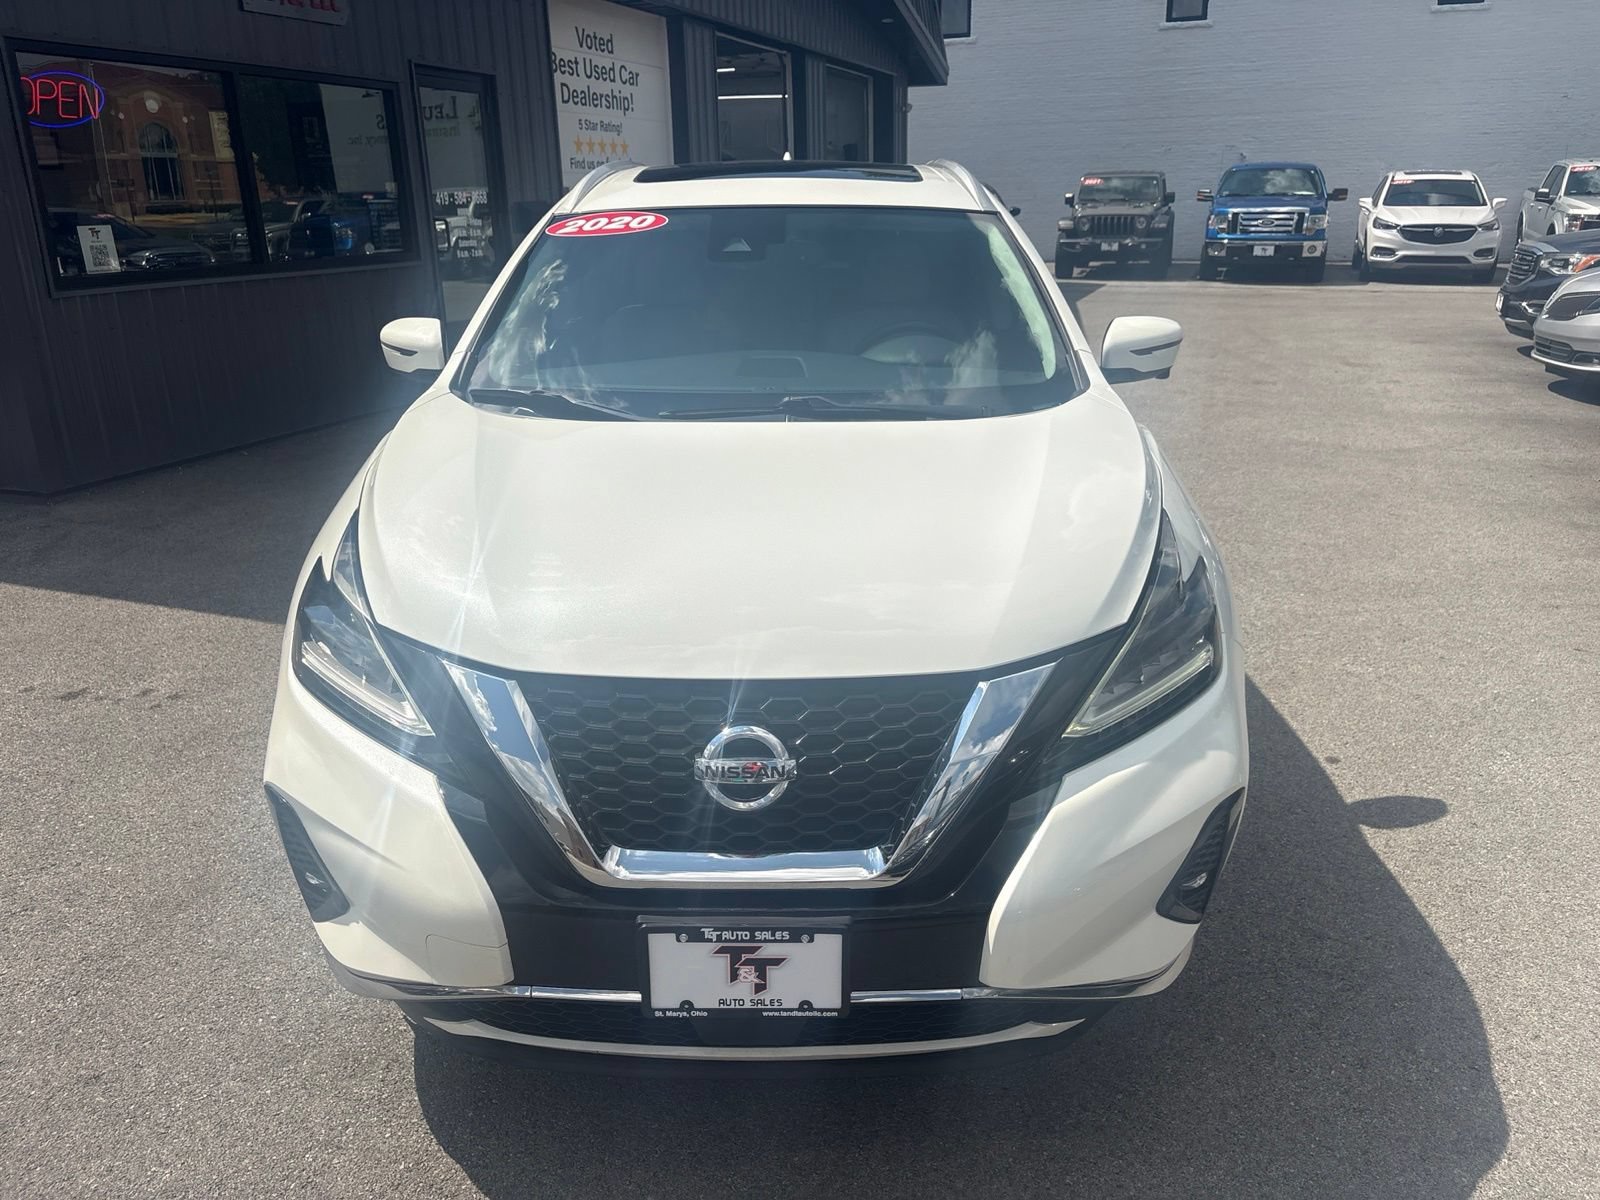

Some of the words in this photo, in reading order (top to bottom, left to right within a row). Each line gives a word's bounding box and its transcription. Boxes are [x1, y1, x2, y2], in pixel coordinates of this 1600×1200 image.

[575, 26, 614, 54] Voted
[552, 51, 580, 77] Best
[583, 57, 616, 83] Used
[619, 65, 640, 87] Car
[20, 76, 99, 120] OPEN
[560, 82, 634, 116] Dealership!
[578, 119, 583, 130] 5
[584, 119, 598, 131] Star
[600, 120, 623, 136] Rating!
[570, 157, 586, 170] Find
[587, 161, 596, 170] us
[555, 215, 656, 234] 2020
[705, 764, 785, 779] NISSAN
[722, 931, 750, 941] AUTO
[755, 931, 790, 940] SALES
[711, 945, 791, 997] T&T
[718, 999, 745, 1008] AUTO
[750, 999, 783, 1007] SALES
[666, 1010, 690, 1018] Marys,
